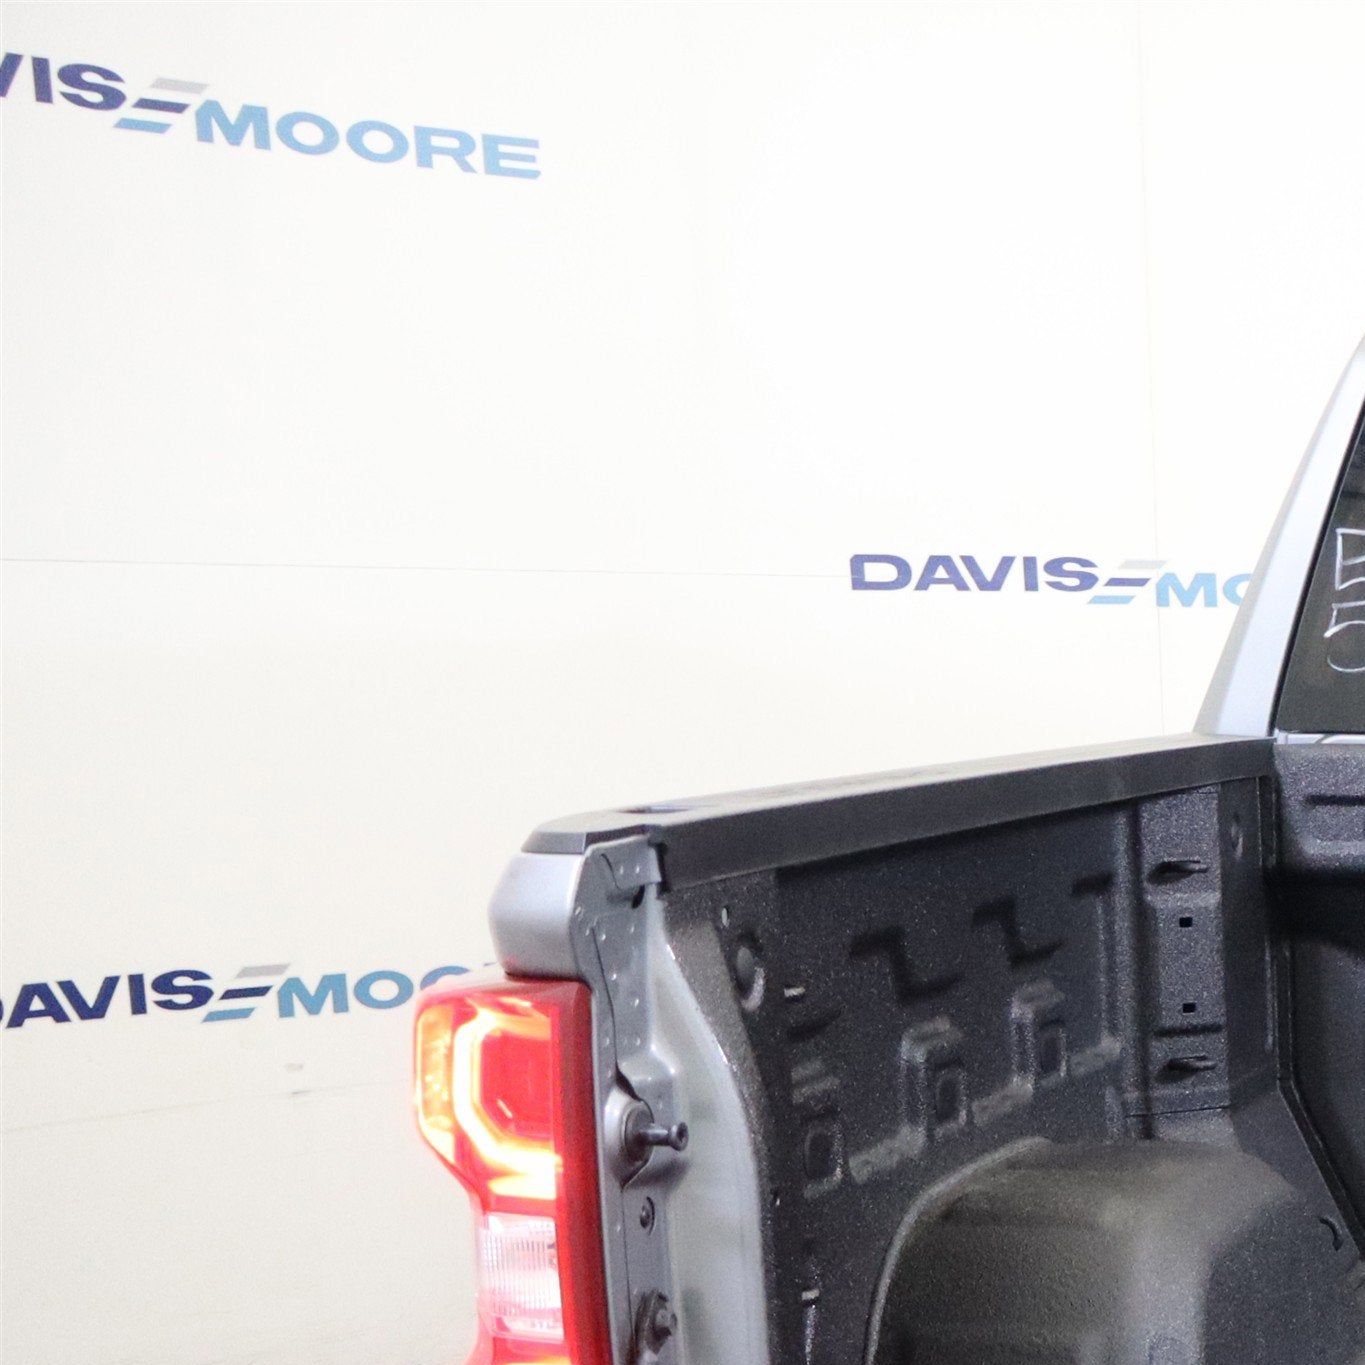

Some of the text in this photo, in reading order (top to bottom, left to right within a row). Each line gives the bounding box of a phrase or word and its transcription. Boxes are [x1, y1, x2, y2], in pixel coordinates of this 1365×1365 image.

[195, 99, 541, 180] MOORE
[850, 554, 1099, 592] DAVIS
[0, 969, 214, 1028] AVIS
